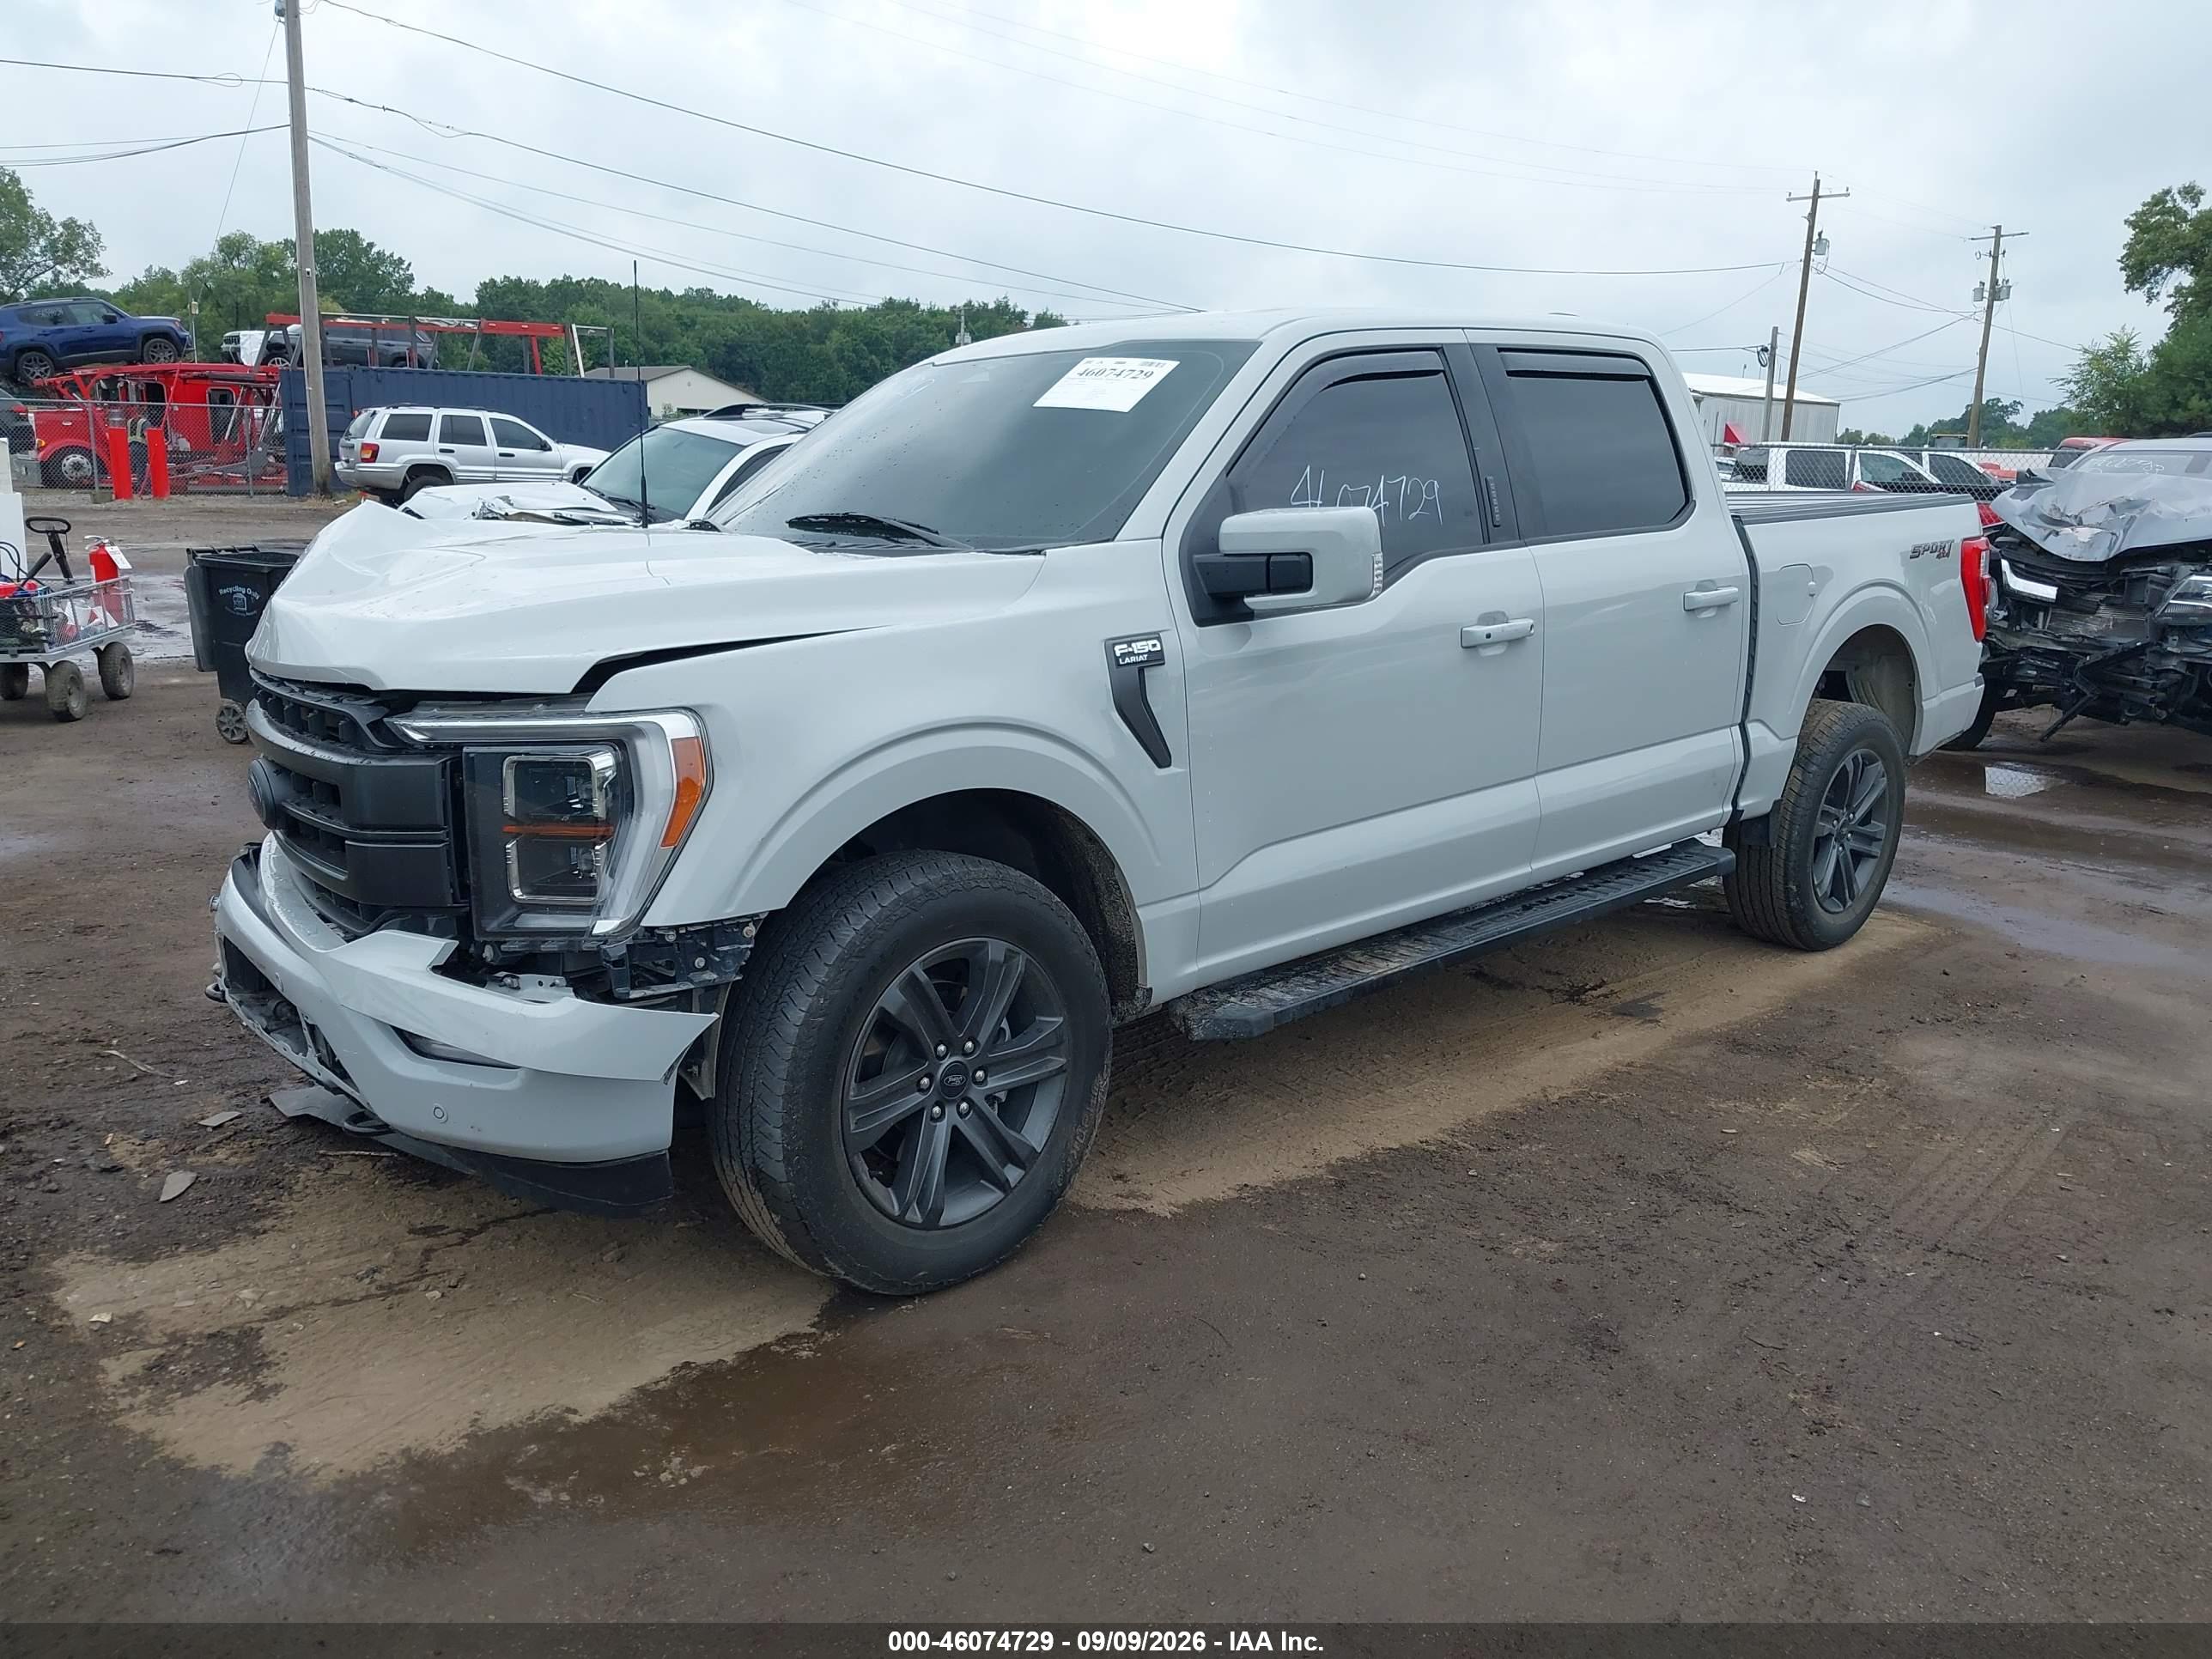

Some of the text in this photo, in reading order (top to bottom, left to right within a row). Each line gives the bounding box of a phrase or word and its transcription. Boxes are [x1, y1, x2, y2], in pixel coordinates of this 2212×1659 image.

[1077, 368, 1154, 380] 46074729
[1909, 539, 1954, 560] SPORT
[219, 586, 260, 600] Recycling Only
[1114, 639, 1161, 657] F-150
[1119, 653, 1148, 665] LARIAT
